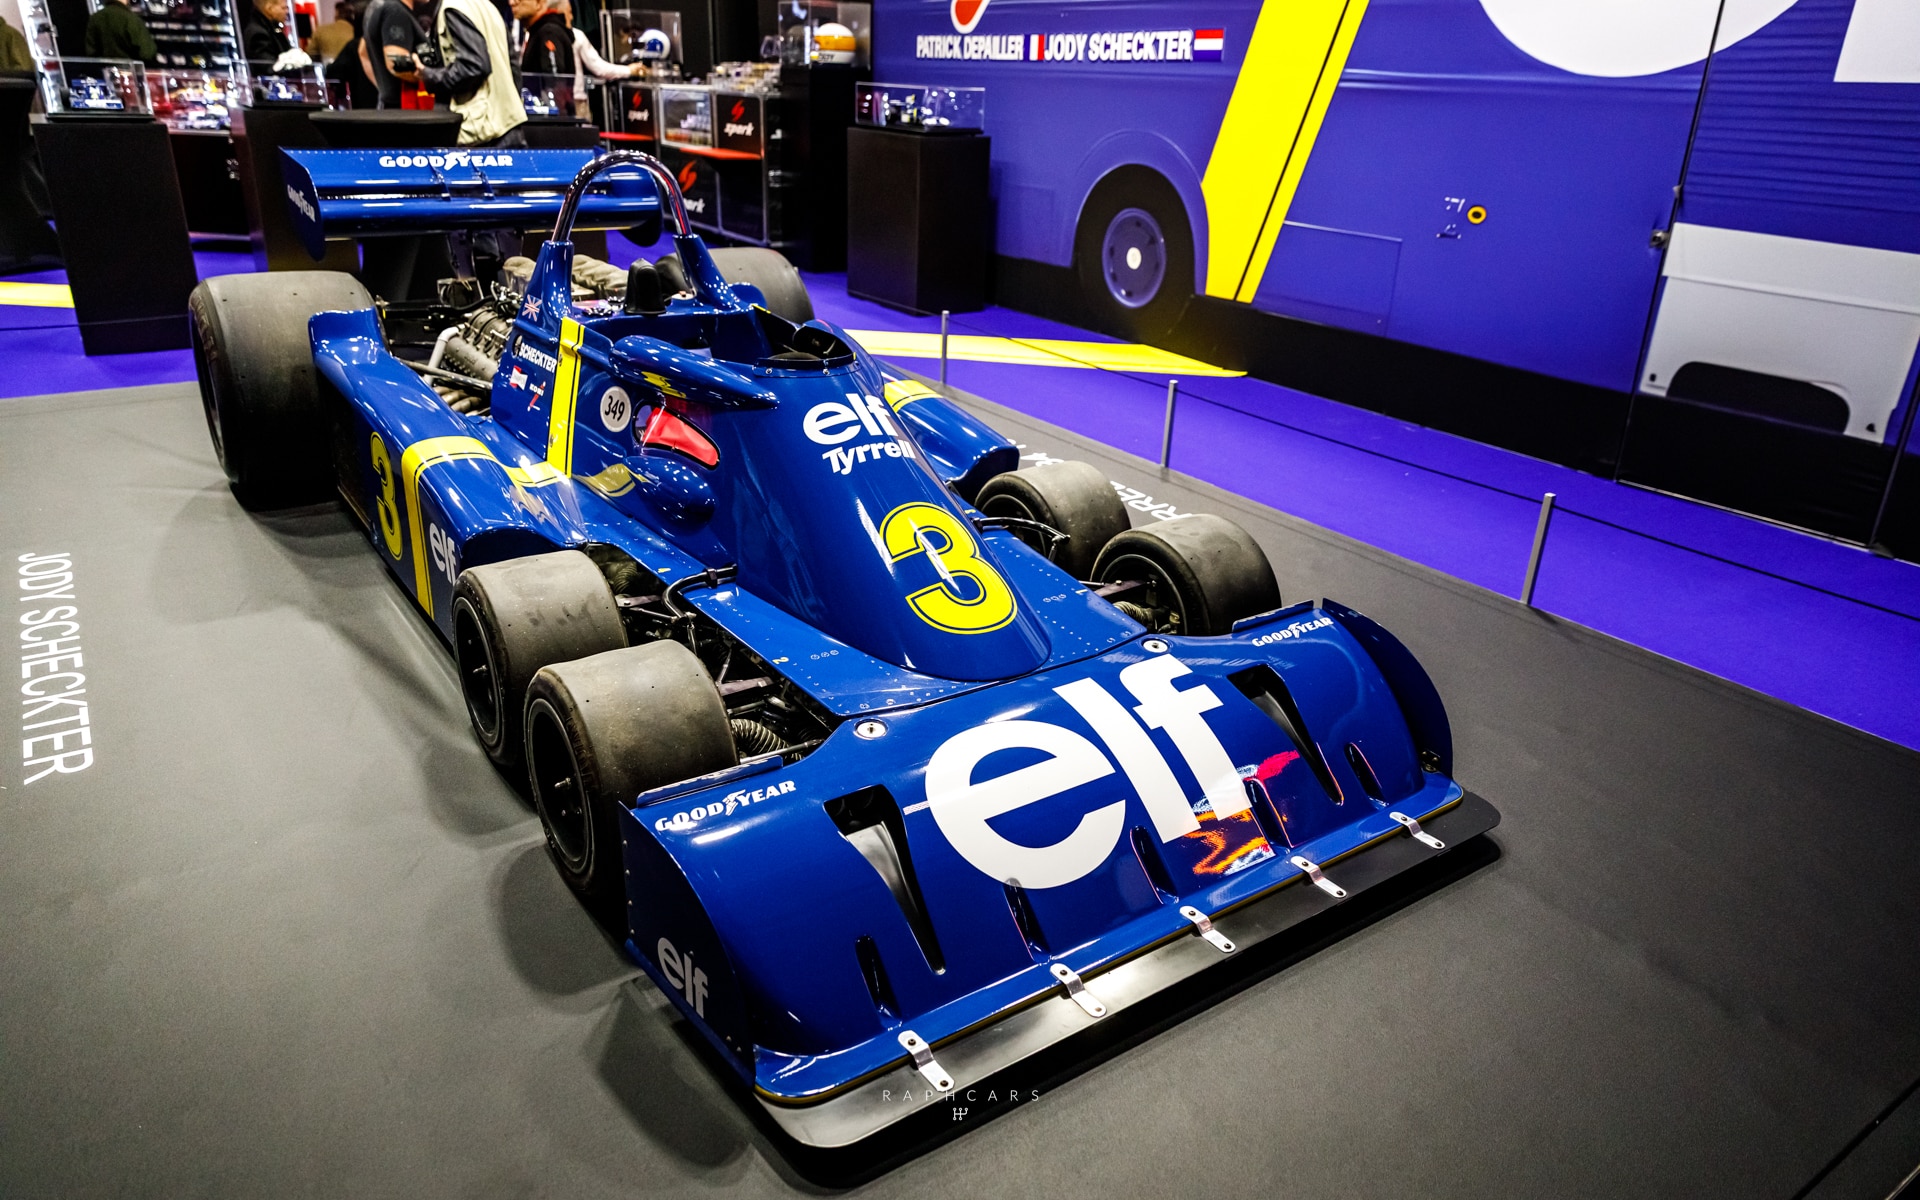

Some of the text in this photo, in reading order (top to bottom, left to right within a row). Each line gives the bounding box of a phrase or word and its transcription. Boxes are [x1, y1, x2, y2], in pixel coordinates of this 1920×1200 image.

[916, 30, 1193, 61] PATRICK DEPAILLER JODY SCHECKTER
[724, 122, 755, 137] spark
[379, 152, 513, 170] GOODYEAR
[518, 342, 558, 374] SCHECKTER
[604, 395, 625, 421] 349
[803, 393, 898, 445] elf
[822, 439, 916, 475] Tyrrell
[370, 431, 403, 561] 3
[429, 522, 457, 587] elf
[878, 501, 1018, 635] 3
[1251, 617, 1335, 647] GOODYEAR
[18, 552, 94, 785] JODY SCHECKTER
[924, 653, 1253, 889] elf
[655, 780, 796, 832] GOODYEAR
[657, 937, 709, 1019] elf
